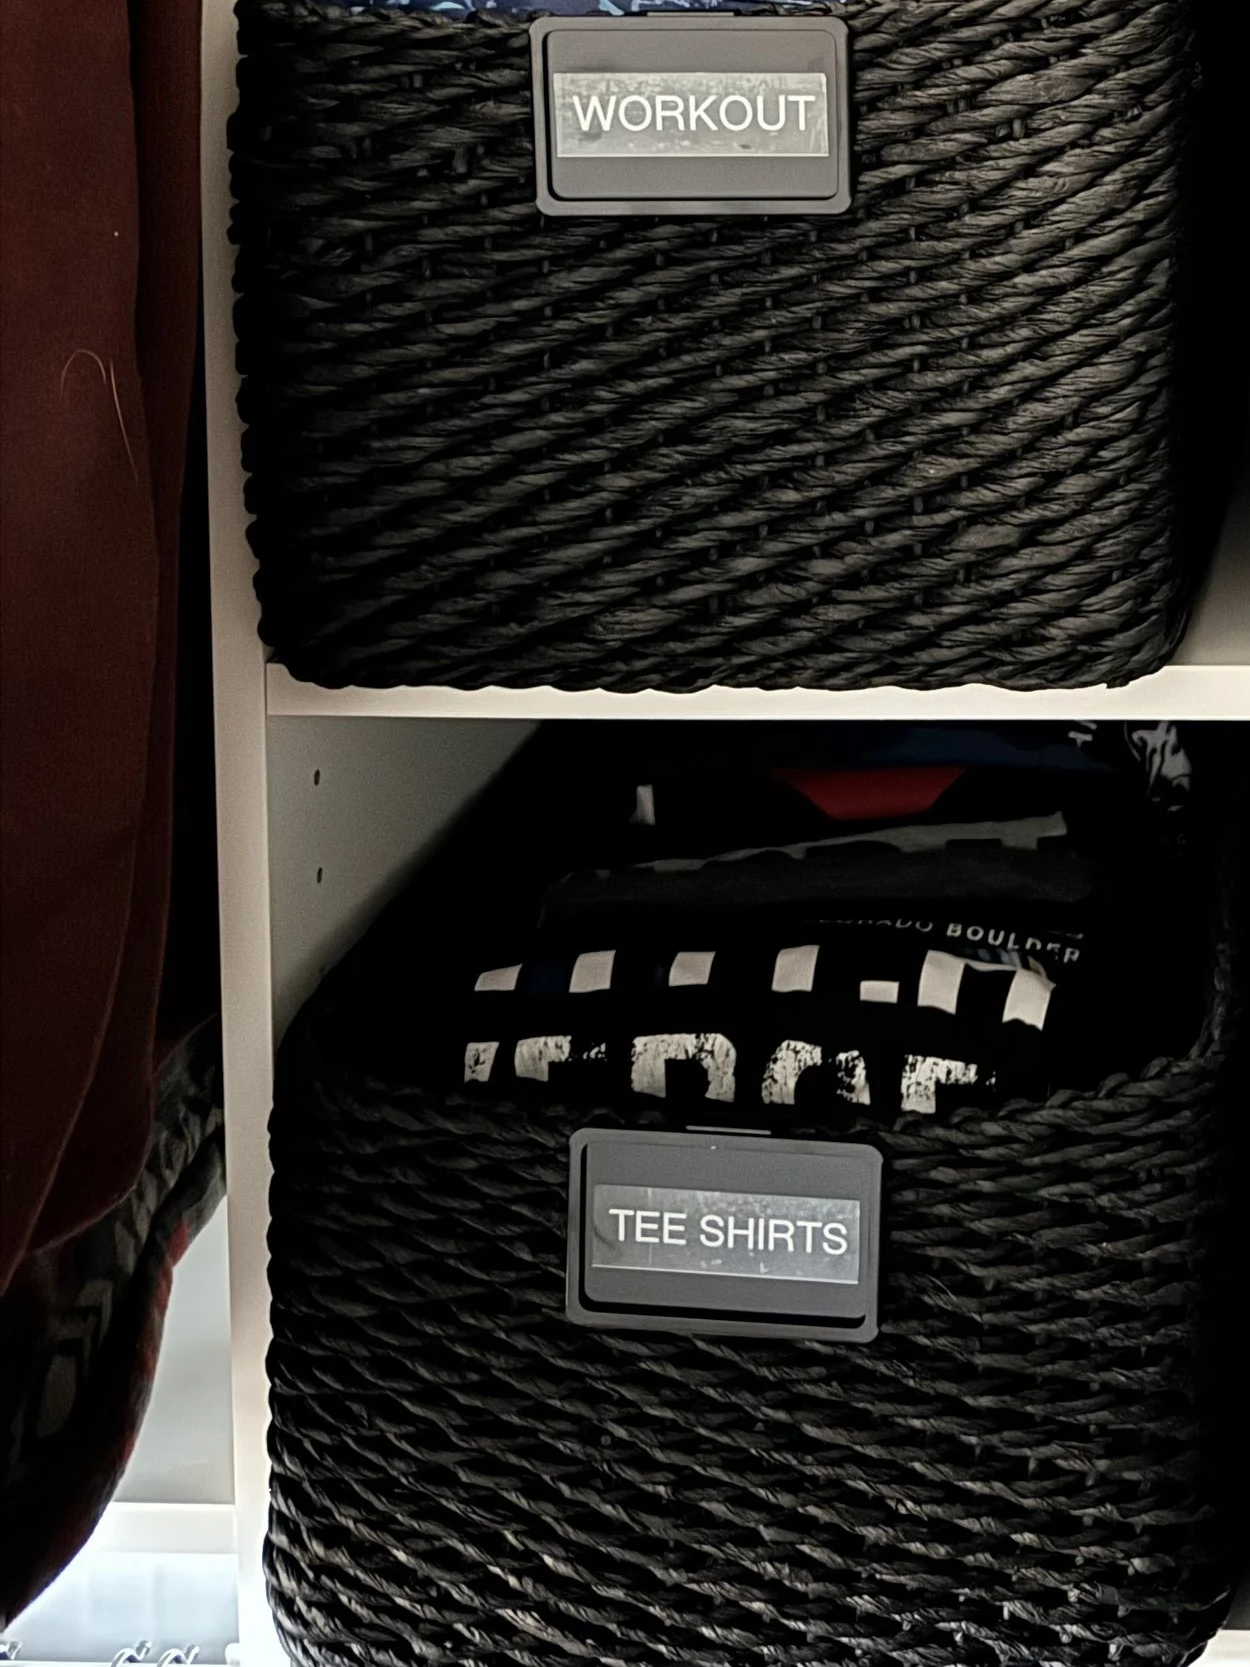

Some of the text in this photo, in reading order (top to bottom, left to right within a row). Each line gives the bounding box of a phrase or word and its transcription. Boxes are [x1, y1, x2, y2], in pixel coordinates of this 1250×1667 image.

[576, 93, 815, 132] WORKOUT
[609, 1207, 848, 1255] TEE SHIRTS
